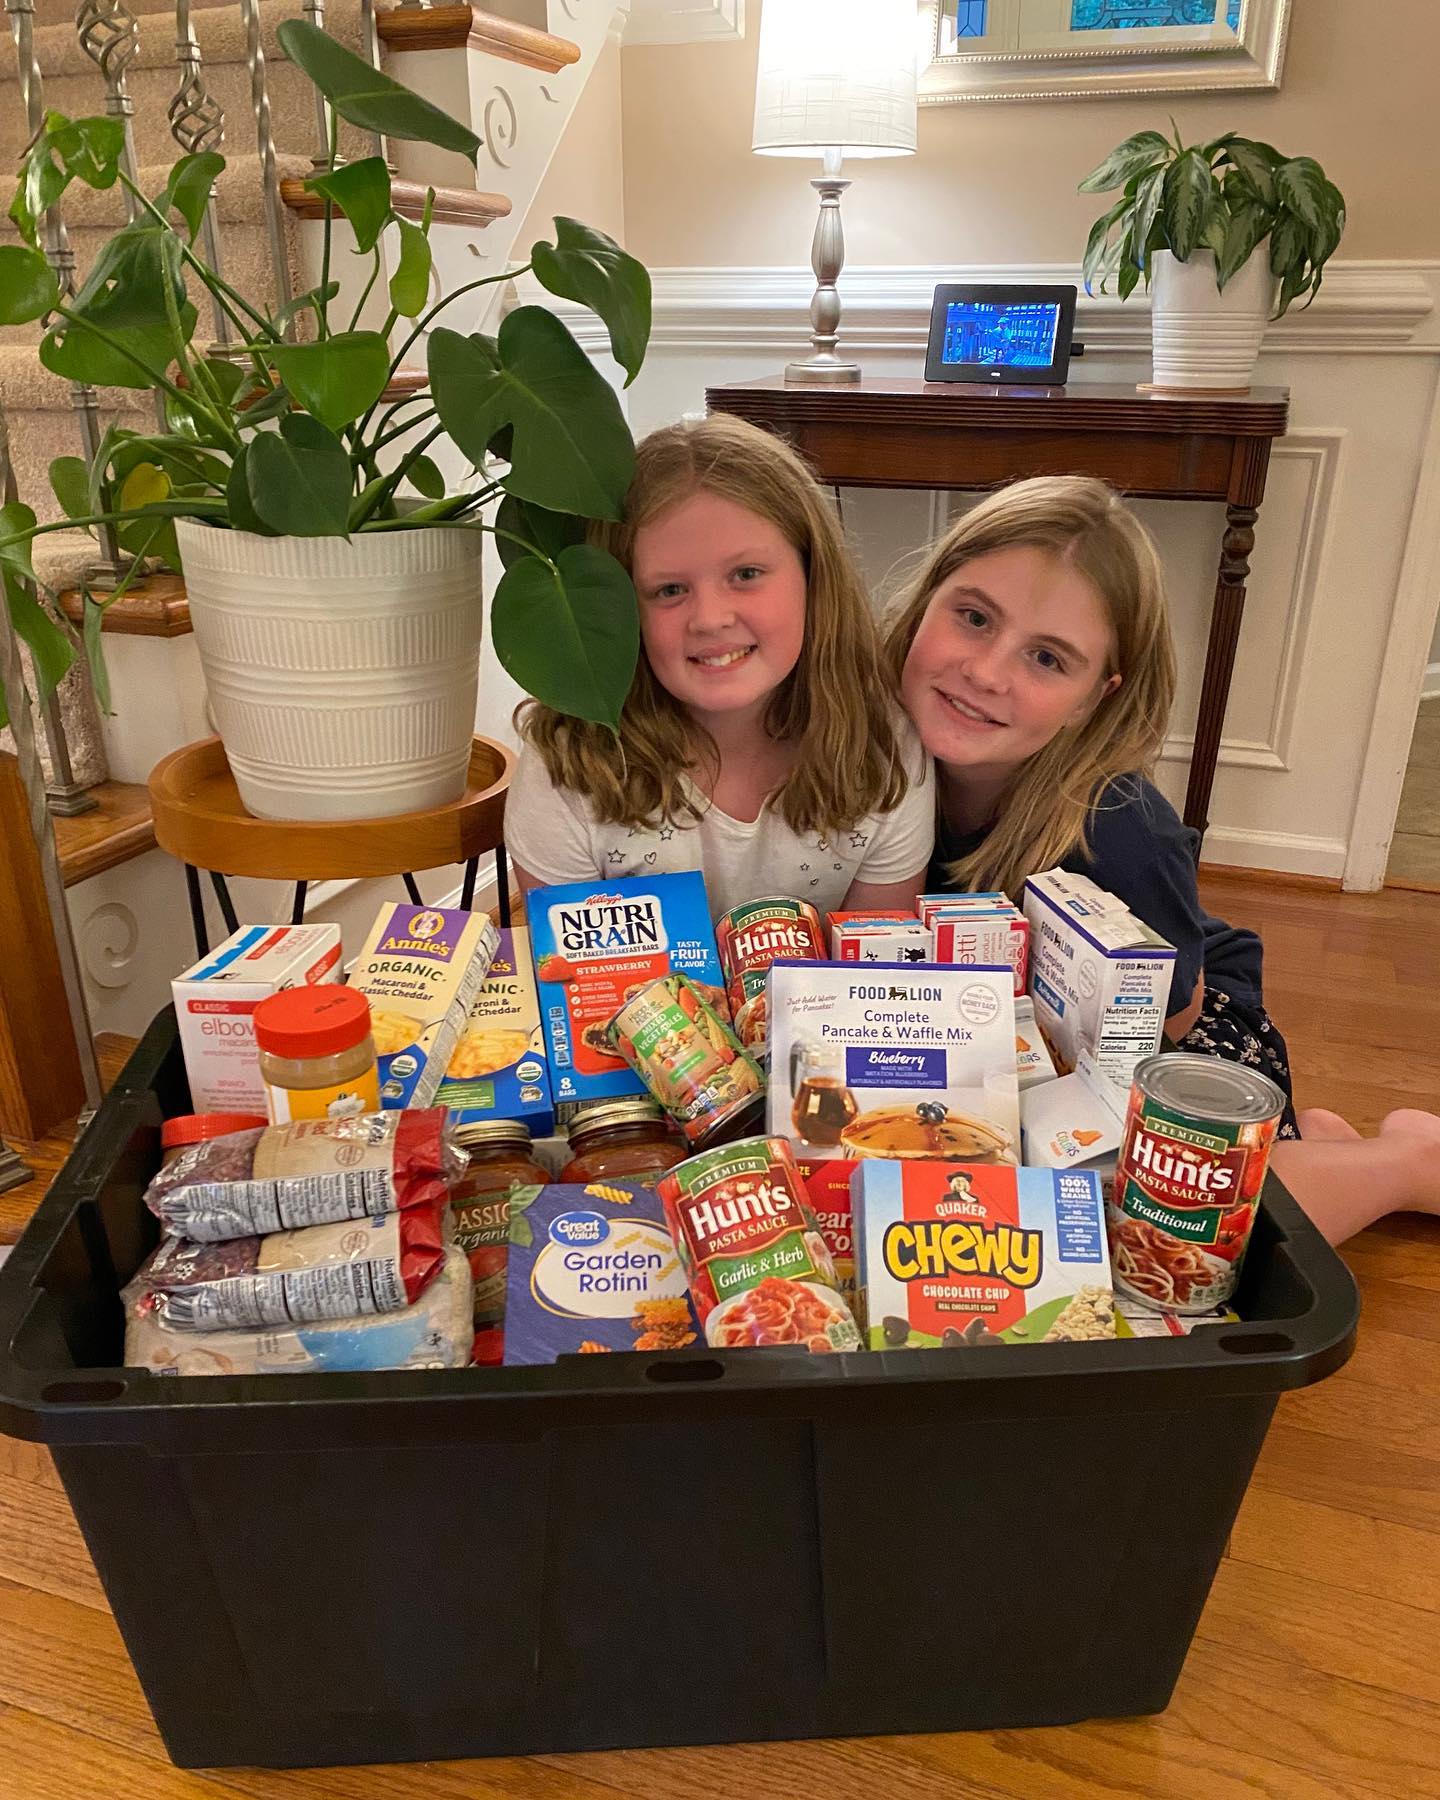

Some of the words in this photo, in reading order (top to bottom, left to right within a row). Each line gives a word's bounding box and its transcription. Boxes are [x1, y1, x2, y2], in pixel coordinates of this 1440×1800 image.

[560, 903, 655, 934] NUTRI
[745, 909, 789, 924] PREMIUM
[563, 919, 658, 950] GRAIN
[735, 926, 811, 960] Hunt's
[381, 937, 451, 957] Annie's
[566, 952, 582, 960] SOFT
[583, 950, 605, 959] BAKED
[605, 947, 641, 956] BREAKFAST
[642, 943, 660, 952] BARS
[670, 949, 709, 960] FRUIT
[745, 952, 773, 967] PASTA
[775, 948, 806, 959] SAUCE
[368, 962, 444, 982] ORGANIC
[576, 960, 652, 975] STRAWBERRY
[371, 977, 417, 990] Macaroni
[420, 982, 426, 990] &
[391, 989, 434, 1001] Cheddar
[473, 999, 499, 1008] aroni
[502, 998, 510, 1007] &
[849, 986, 886, 1000] FOOD
[910, 988, 942, 1001] LION
[478, 1006, 522, 1017] Cheddar
[864, 1010, 929, 1023] Complete
[639, 1012, 683, 1050] VEGETABLES
[642, 1013, 667, 1037] MIXED
[822, 1024, 878, 1038] Pancake
[882, 1026, 893, 1038] &
[896, 1027, 943, 1039] Waffle
[947, 1029, 973, 1040] Mix
[868, 1051, 925, 1071] Blueberry
[560, 1077, 572, 1089] 8
[1154, 1123, 1216, 1148] PREMIUM
[1132, 1131, 1232, 1191] Hunt's
[699, 1161, 757, 1187] PREMIUM
[1059, 1178, 1090, 1188] 100%
[1135, 1167, 1168, 1193] PASTA
[1171, 1186, 1216, 1203] SAUCE
[688, 1184, 791, 1240] Hunt's
[935, 1203, 987, 1218] QUAKER
[1132, 1197, 1207, 1232] Traditional
[557, 1219, 600, 1233] Great
[567, 1230, 600, 1240] Value
[708, 1231, 747, 1252] PASTA
[749, 1215, 789, 1236] SAUCE
[564, 1251, 662, 1271] Garden
[719, 1263, 758, 1288] Garlic
[759, 1258, 770, 1272] &
[773, 1247, 804, 1268] Herb
[580, 1272, 648, 1293] Rotini
[923, 1285, 982, 1299] CHOCOLATE
[985, 1287, 1010, 1300] CHIP
[951, 1303, 981, 1311] CHOCOLATE
